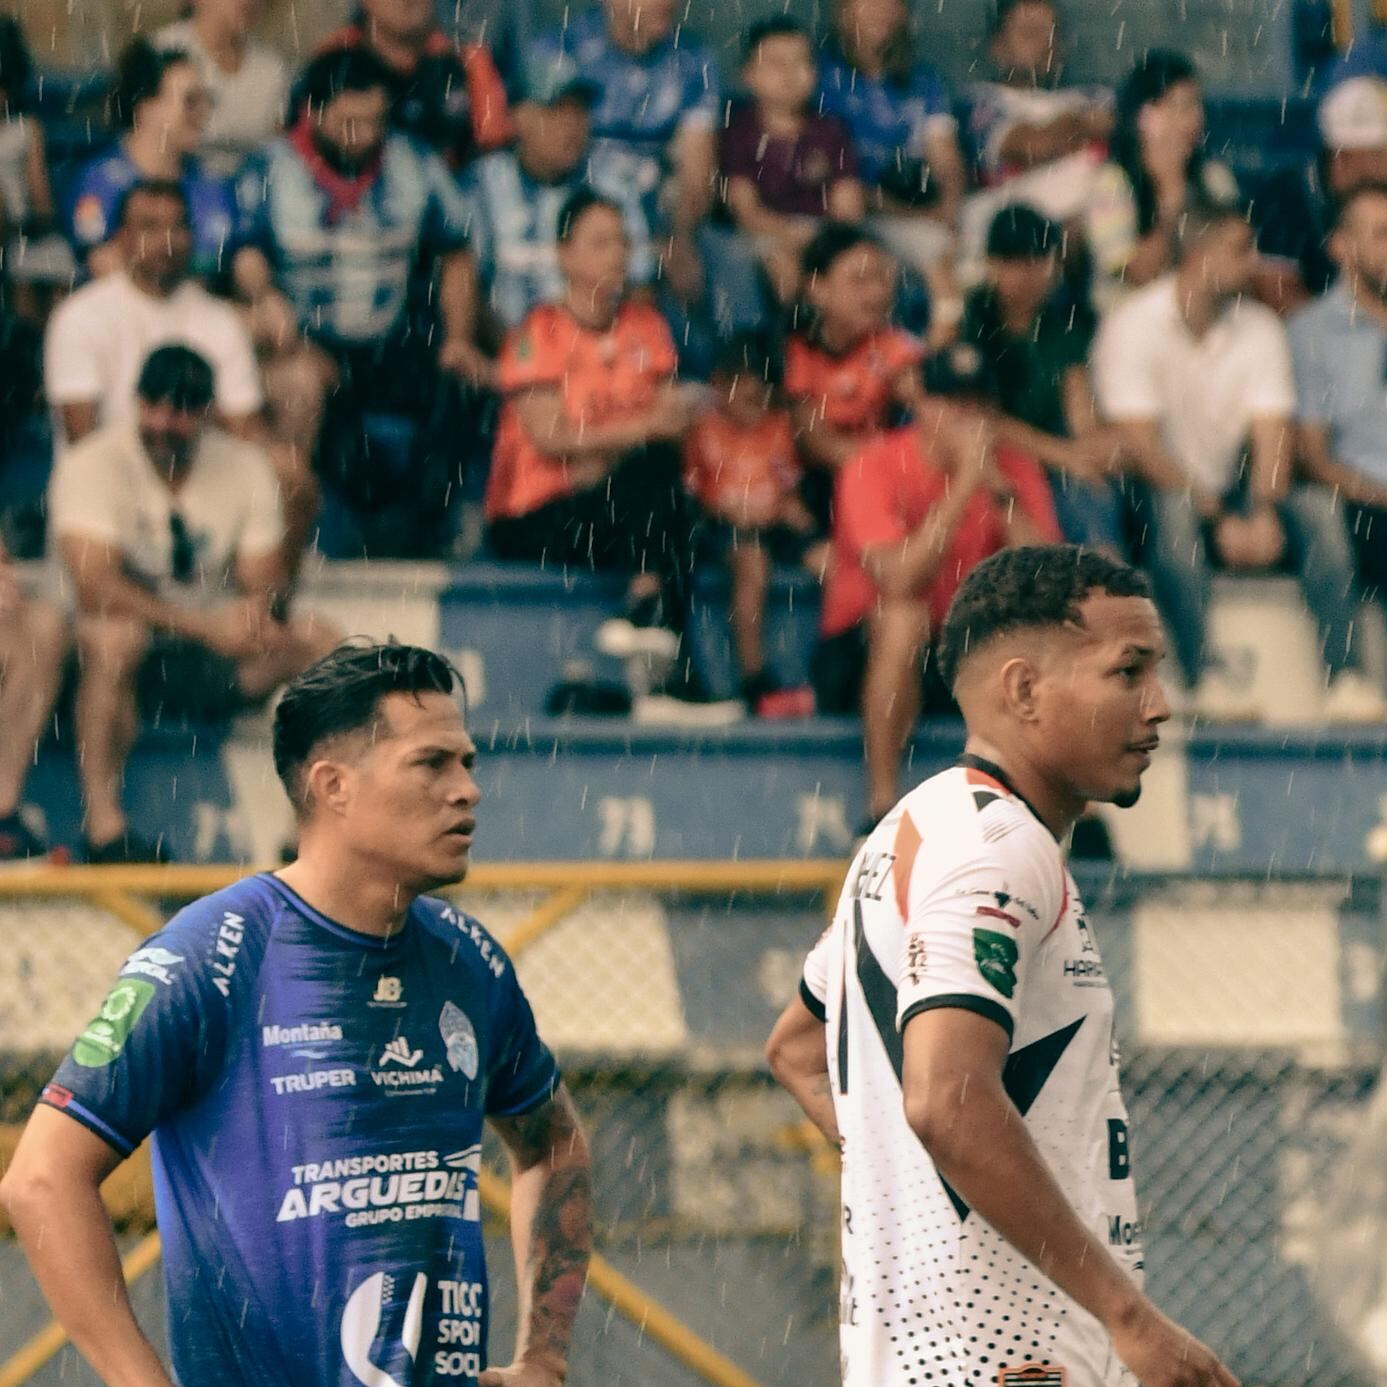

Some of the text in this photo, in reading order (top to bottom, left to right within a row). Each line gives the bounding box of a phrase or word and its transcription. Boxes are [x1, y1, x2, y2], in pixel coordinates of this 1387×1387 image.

[212, 911, 245, 997] ALKEN
[440, 907, 506, 978] ALKEN
[262, 1021, 342, 1047] Montaña
[271, 1069, 357, 1095] TRUPER
[371, 1068, 444, 1086] VICHIMA
[291, 1150, 439, 1184] TRANSPORTES
[345, 1207, 402, 1228] GRUPO
